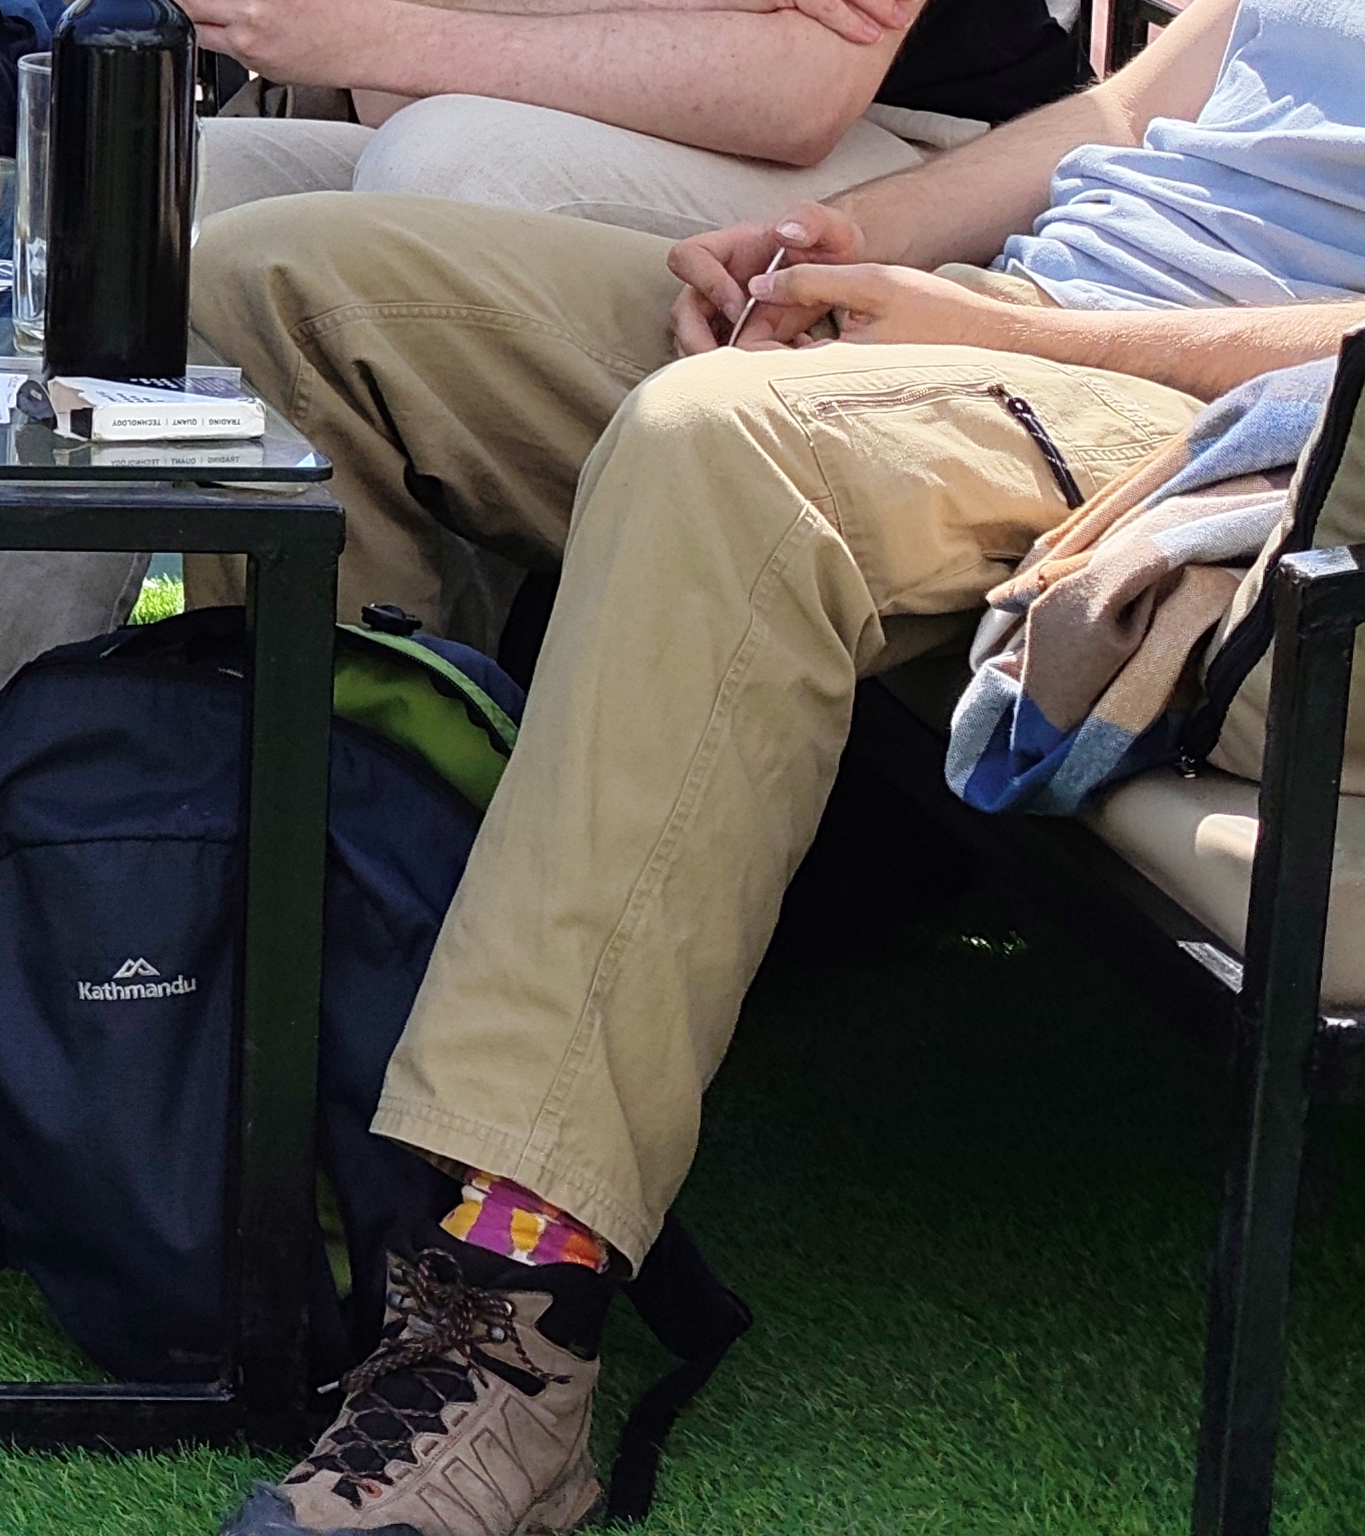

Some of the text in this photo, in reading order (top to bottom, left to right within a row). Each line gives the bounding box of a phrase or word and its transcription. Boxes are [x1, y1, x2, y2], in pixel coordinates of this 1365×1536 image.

[111, 417, 242, 427] TRADING QUANT TECHNOLOGY
[77, 974, 197, 1001] Kathmandu
